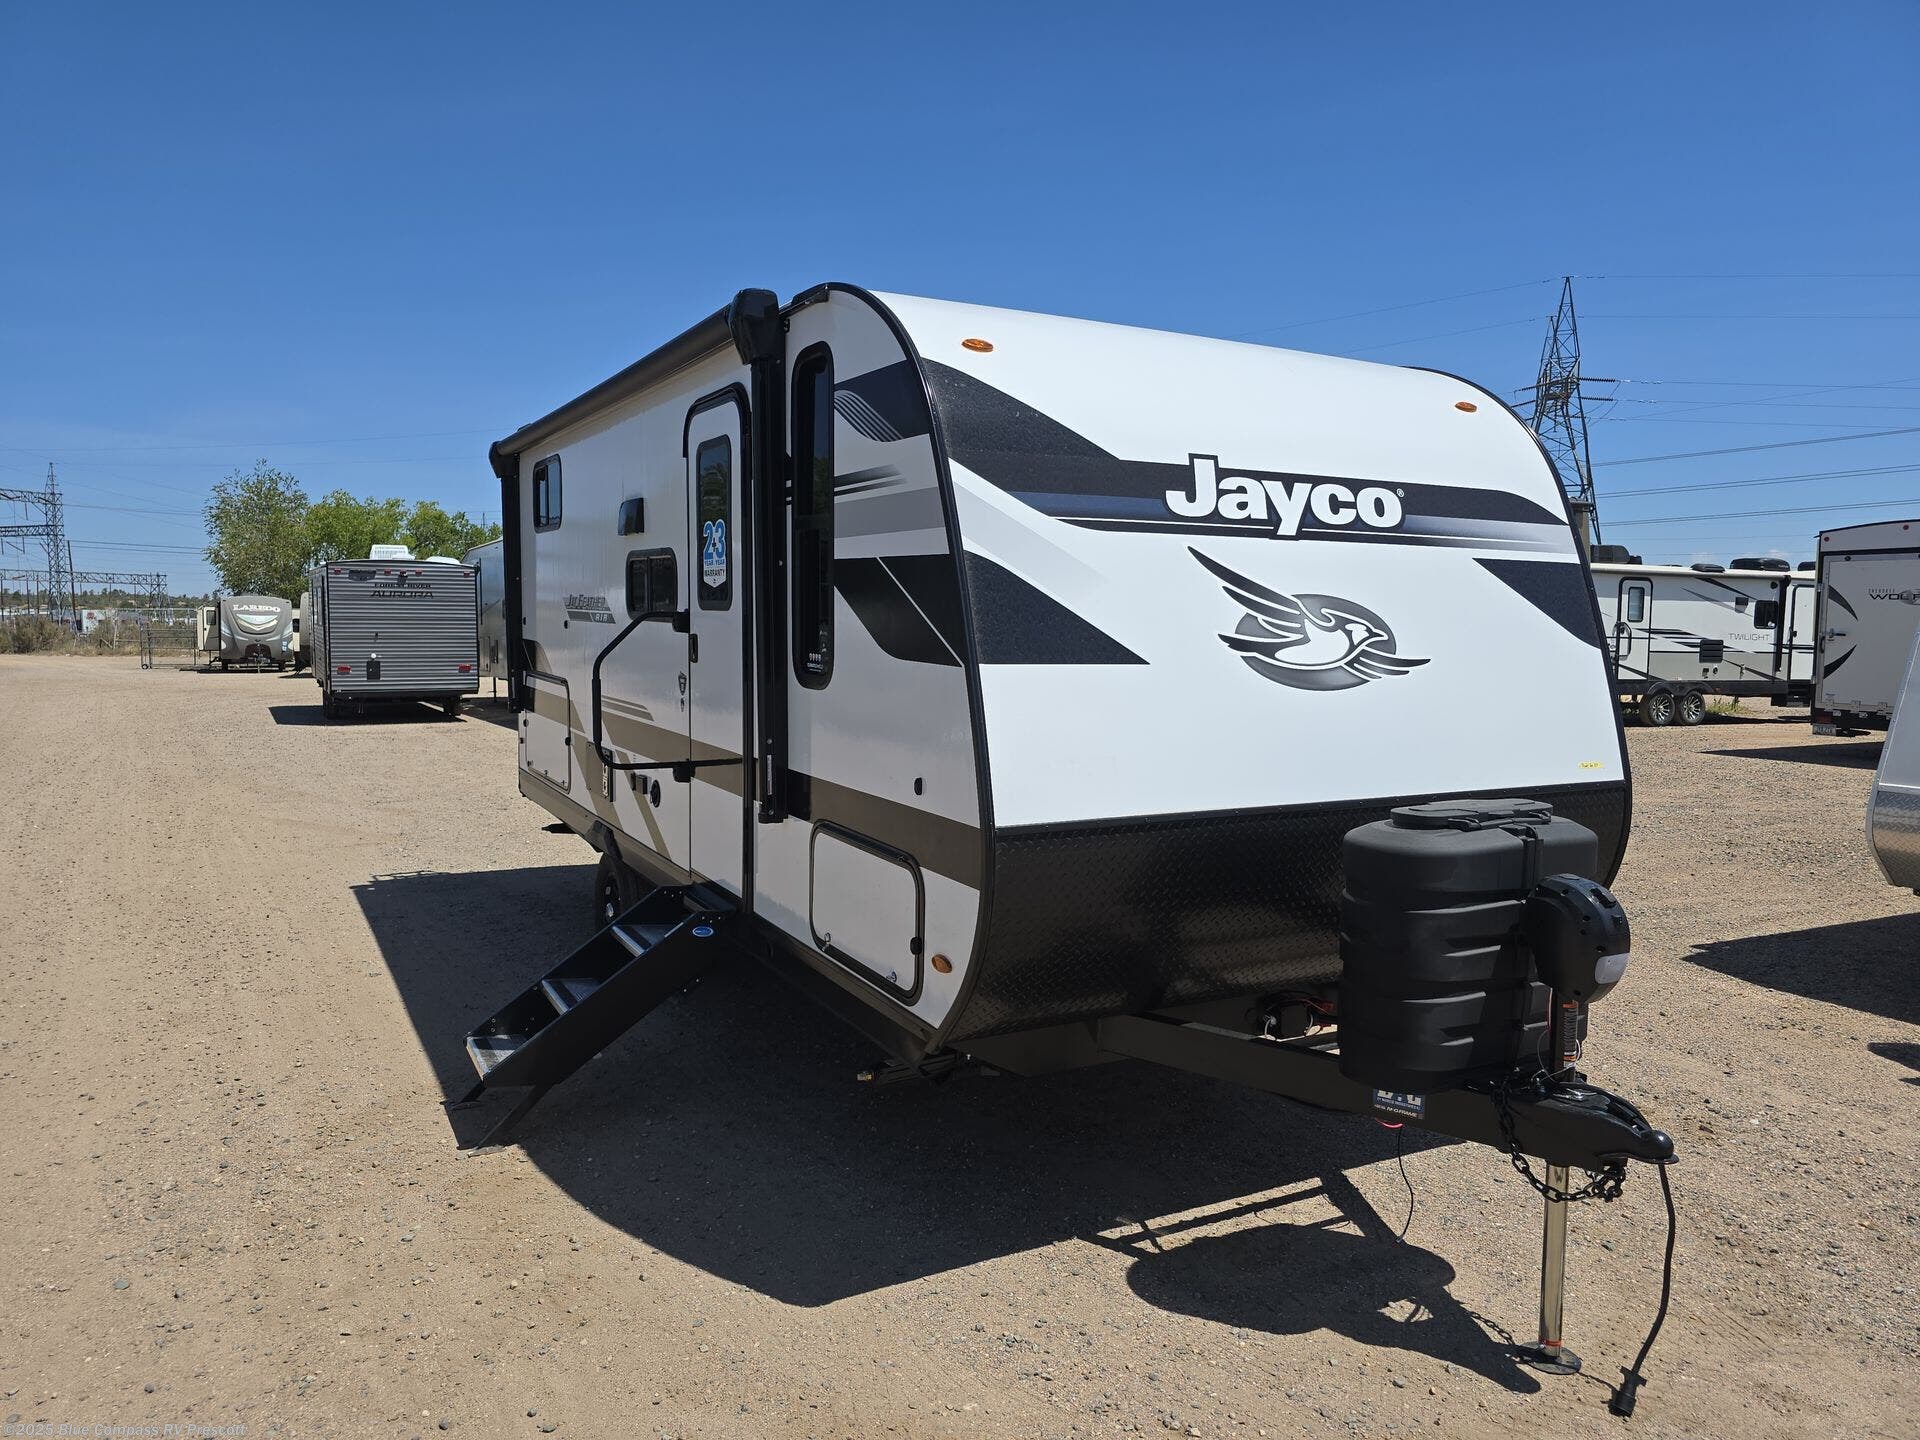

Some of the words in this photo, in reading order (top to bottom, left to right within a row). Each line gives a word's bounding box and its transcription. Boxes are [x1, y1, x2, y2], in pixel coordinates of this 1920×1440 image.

[704, 569, 725, 577] WARRANTY
[371, 590, 434, 598] AURORA
[233, 604, 281, 613] LAREDO
[1728, 633, 1770, 641] TWILIGHT
